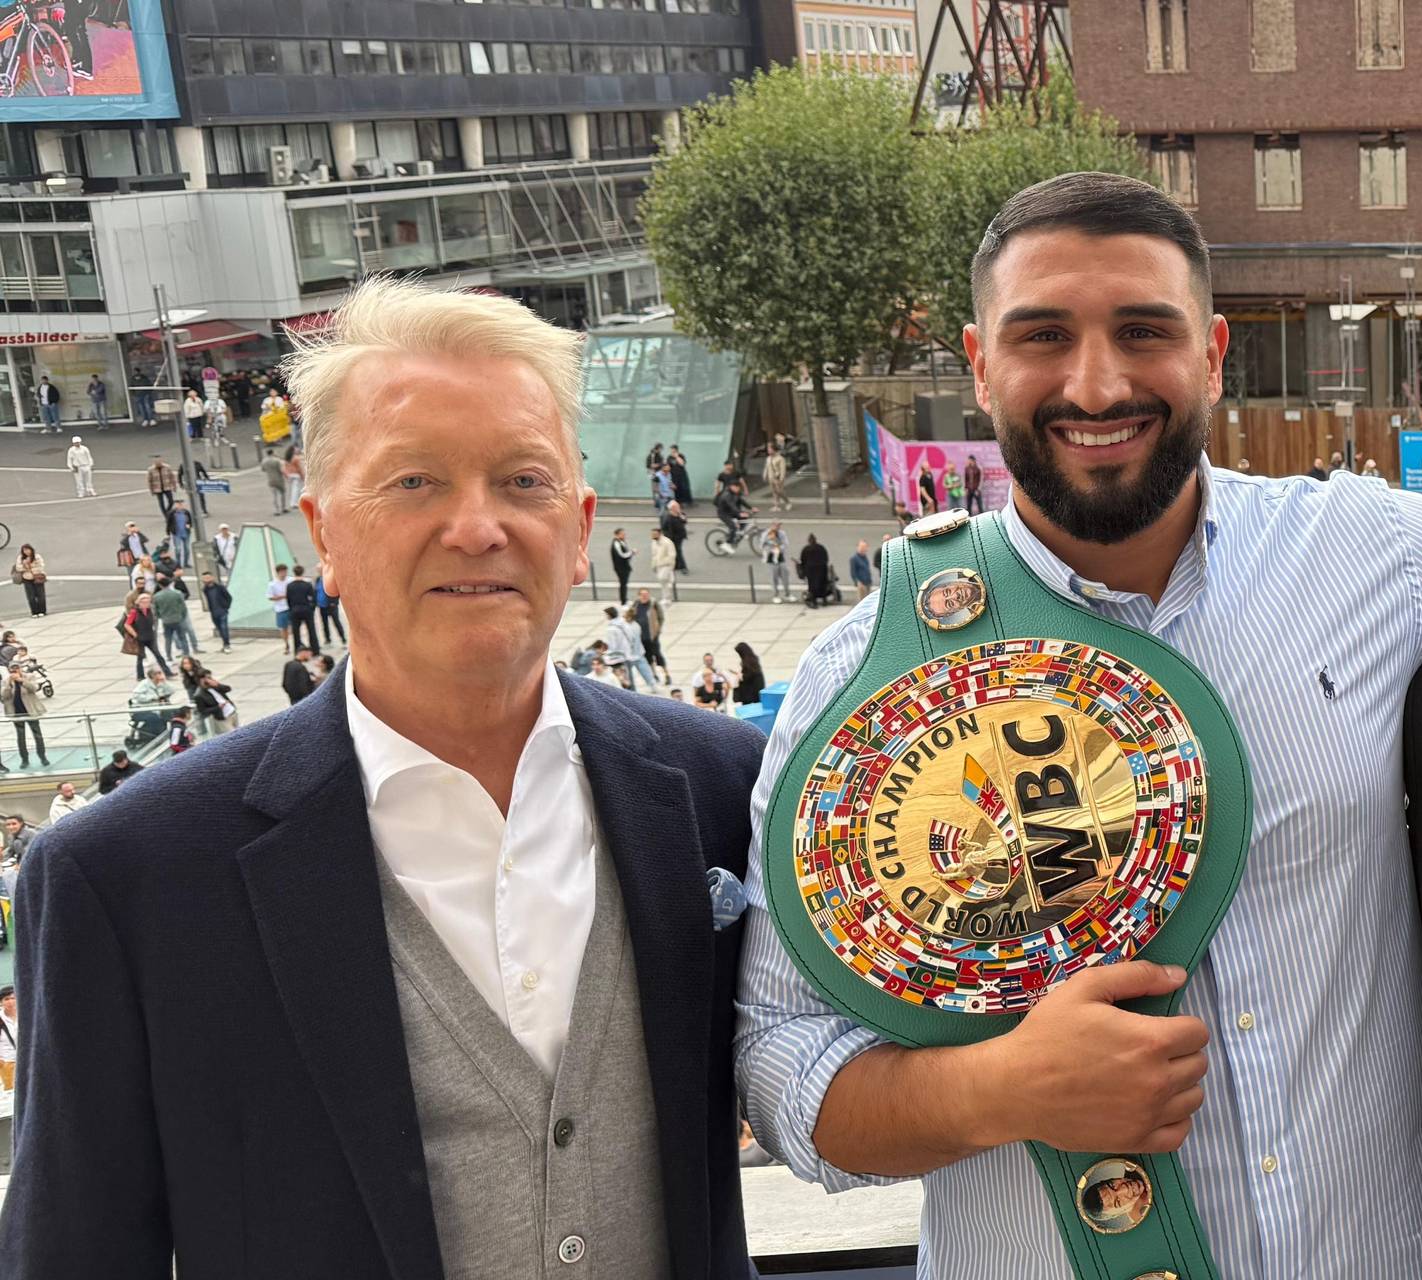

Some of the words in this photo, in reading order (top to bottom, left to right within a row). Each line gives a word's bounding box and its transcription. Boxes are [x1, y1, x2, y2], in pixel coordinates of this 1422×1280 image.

[872, 712, 981, 880] CHAMPION
[1002, 714, 1102, 904] WBC
[900, 885, 1029, 938] WORLD
